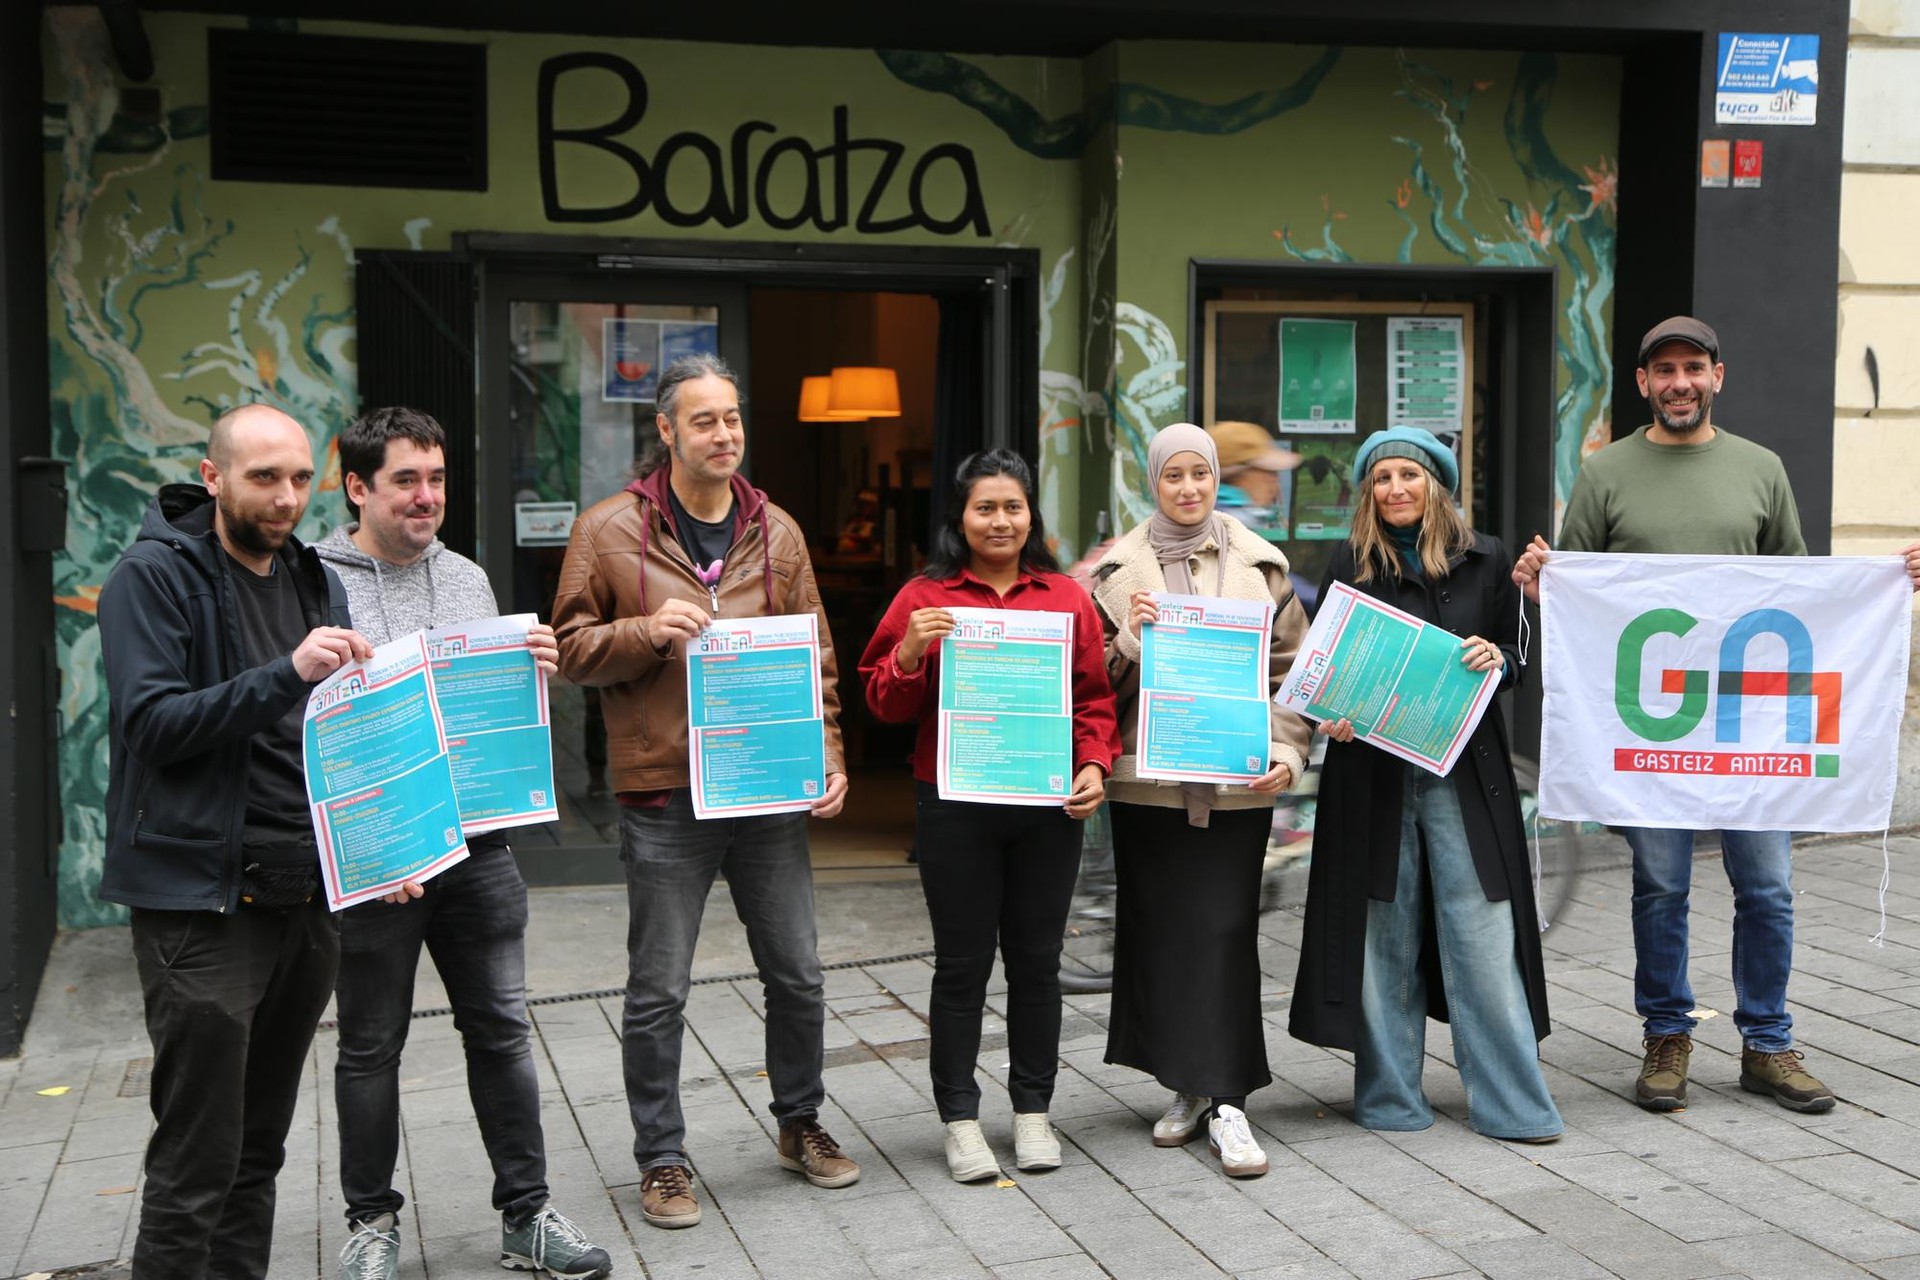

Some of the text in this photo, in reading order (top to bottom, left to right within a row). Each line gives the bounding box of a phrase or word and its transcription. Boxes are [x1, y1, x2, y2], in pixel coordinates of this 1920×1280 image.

[1719, 100, 1759, 116] tyco
[537, 52, 992, 238] Baratza
[1633, 753, 1803, 774] GASTEIZ ANITZA
